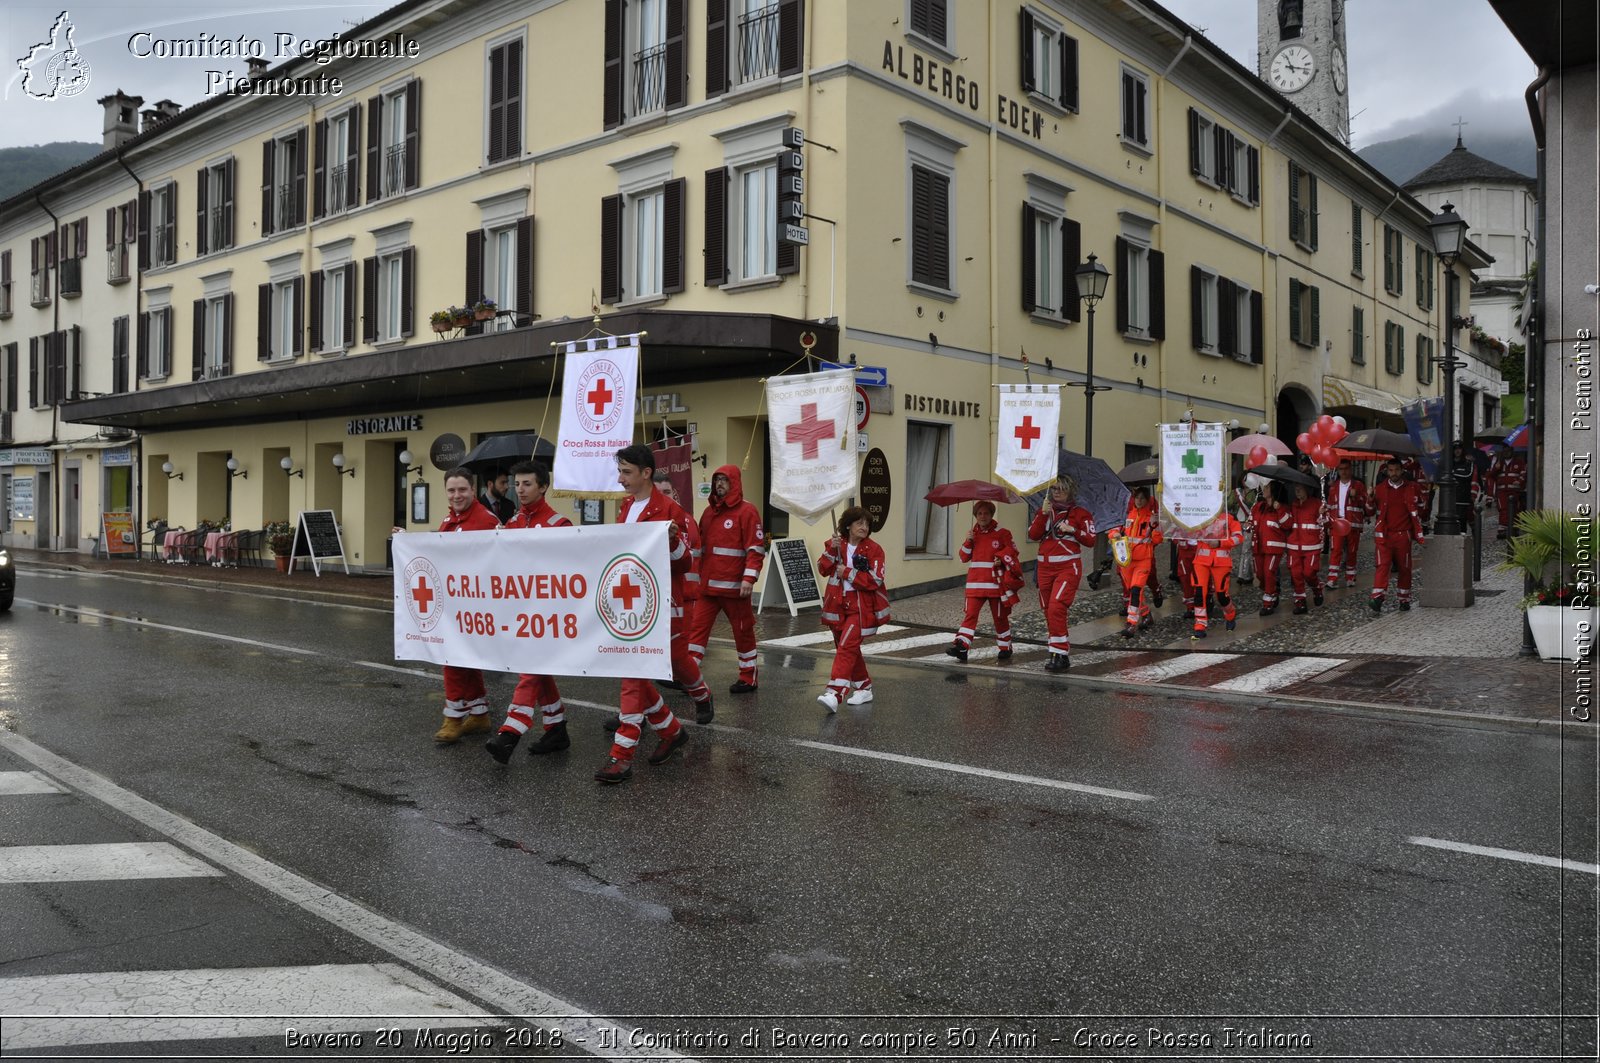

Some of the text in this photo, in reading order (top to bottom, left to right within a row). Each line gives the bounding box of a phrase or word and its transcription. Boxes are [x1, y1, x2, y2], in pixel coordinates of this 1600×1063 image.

[882, 40, 1042, 140] ALBERGO EDEN
[793, 130, 803, 214] EDEN
[787, 228, 808, 241] HOTEL
[904, 393, 980, 419] RISTORANTE
[346, 415, 422, 434] RISTORANTE
[584, 439, 605, 448] Rossa
[446, 573, 588, 600] C.R.I. BAVENO
[456, 610, 496, 637] 1968
[516, 613, 578, 639] 2018
[618, 612, 638, 630] 50
[597, 645, 664, 655] Comitato di Baveno
